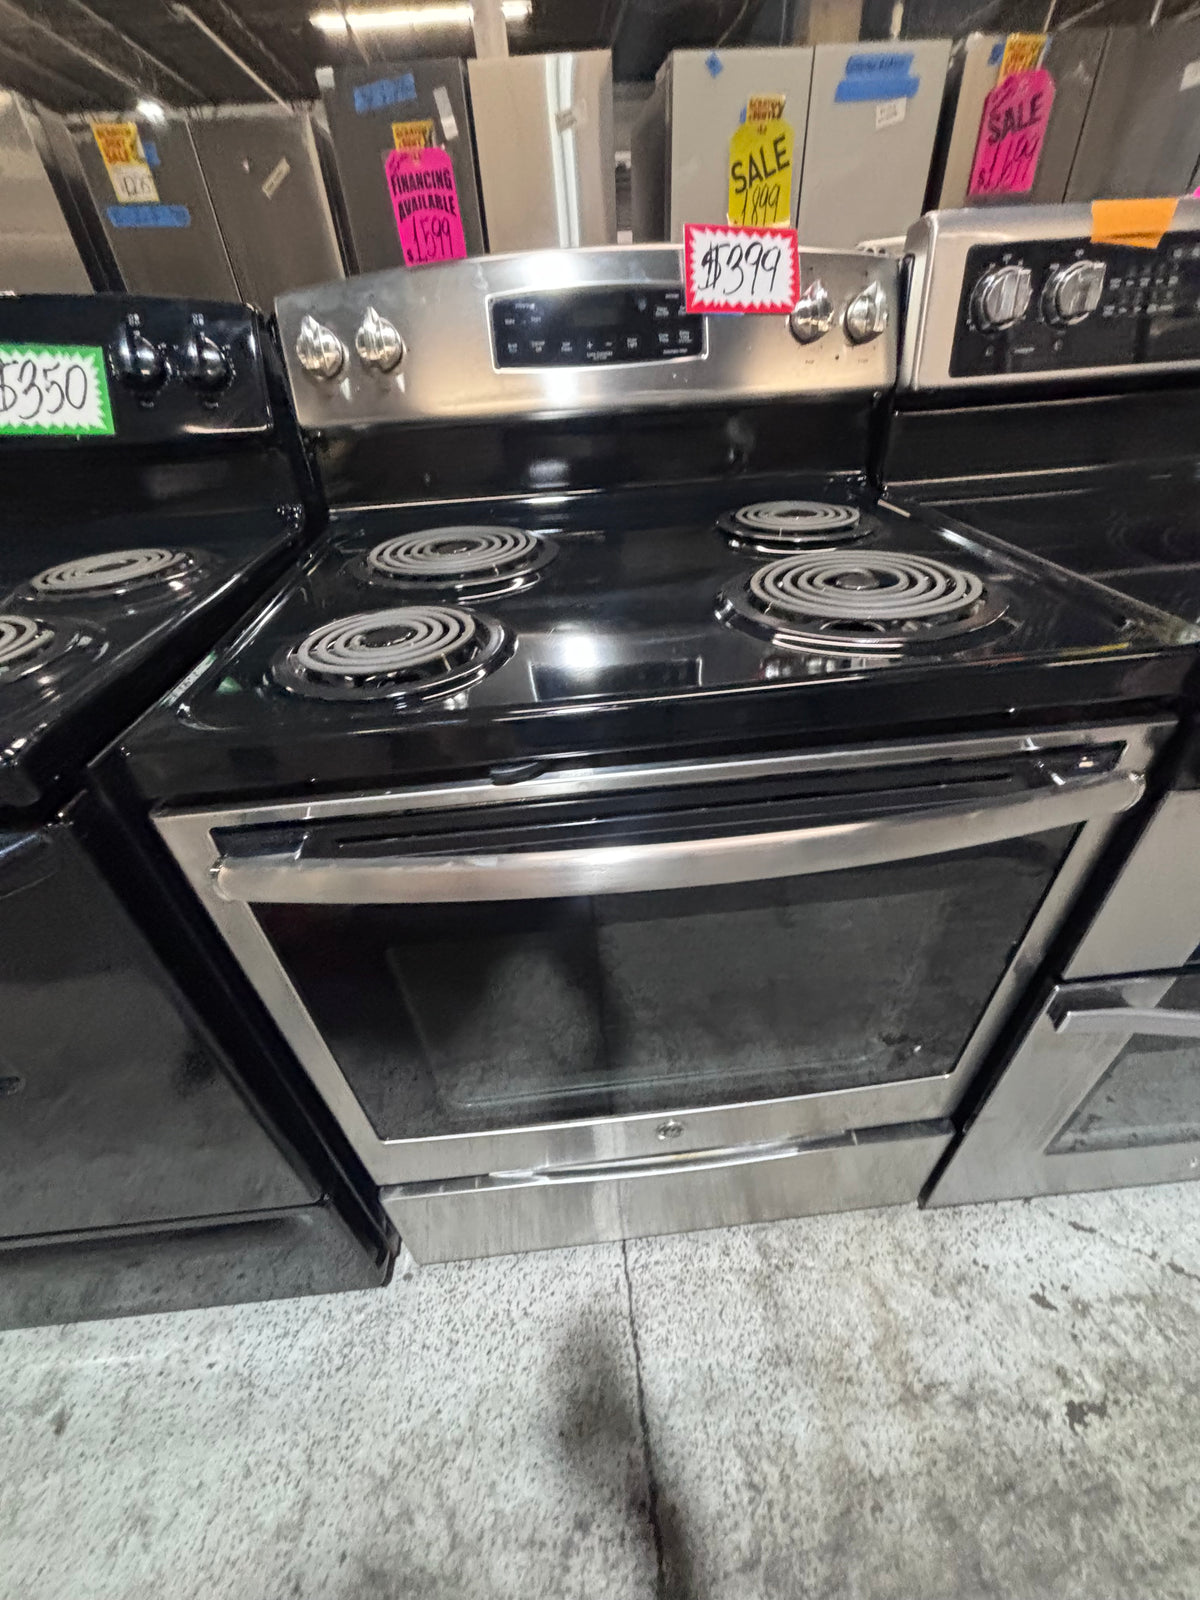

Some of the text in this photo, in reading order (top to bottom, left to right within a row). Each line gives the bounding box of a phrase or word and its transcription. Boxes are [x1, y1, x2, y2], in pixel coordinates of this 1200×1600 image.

[988, 91, 1043, 147] SALE
[390, 168, 454, 197] FINANCING
[731, 135, 790, 195] SALE
[397, 193, 457, 223] AVAILABLE
[698, 241, 781, 296] $399
[0, 358, 88, 420] $350
